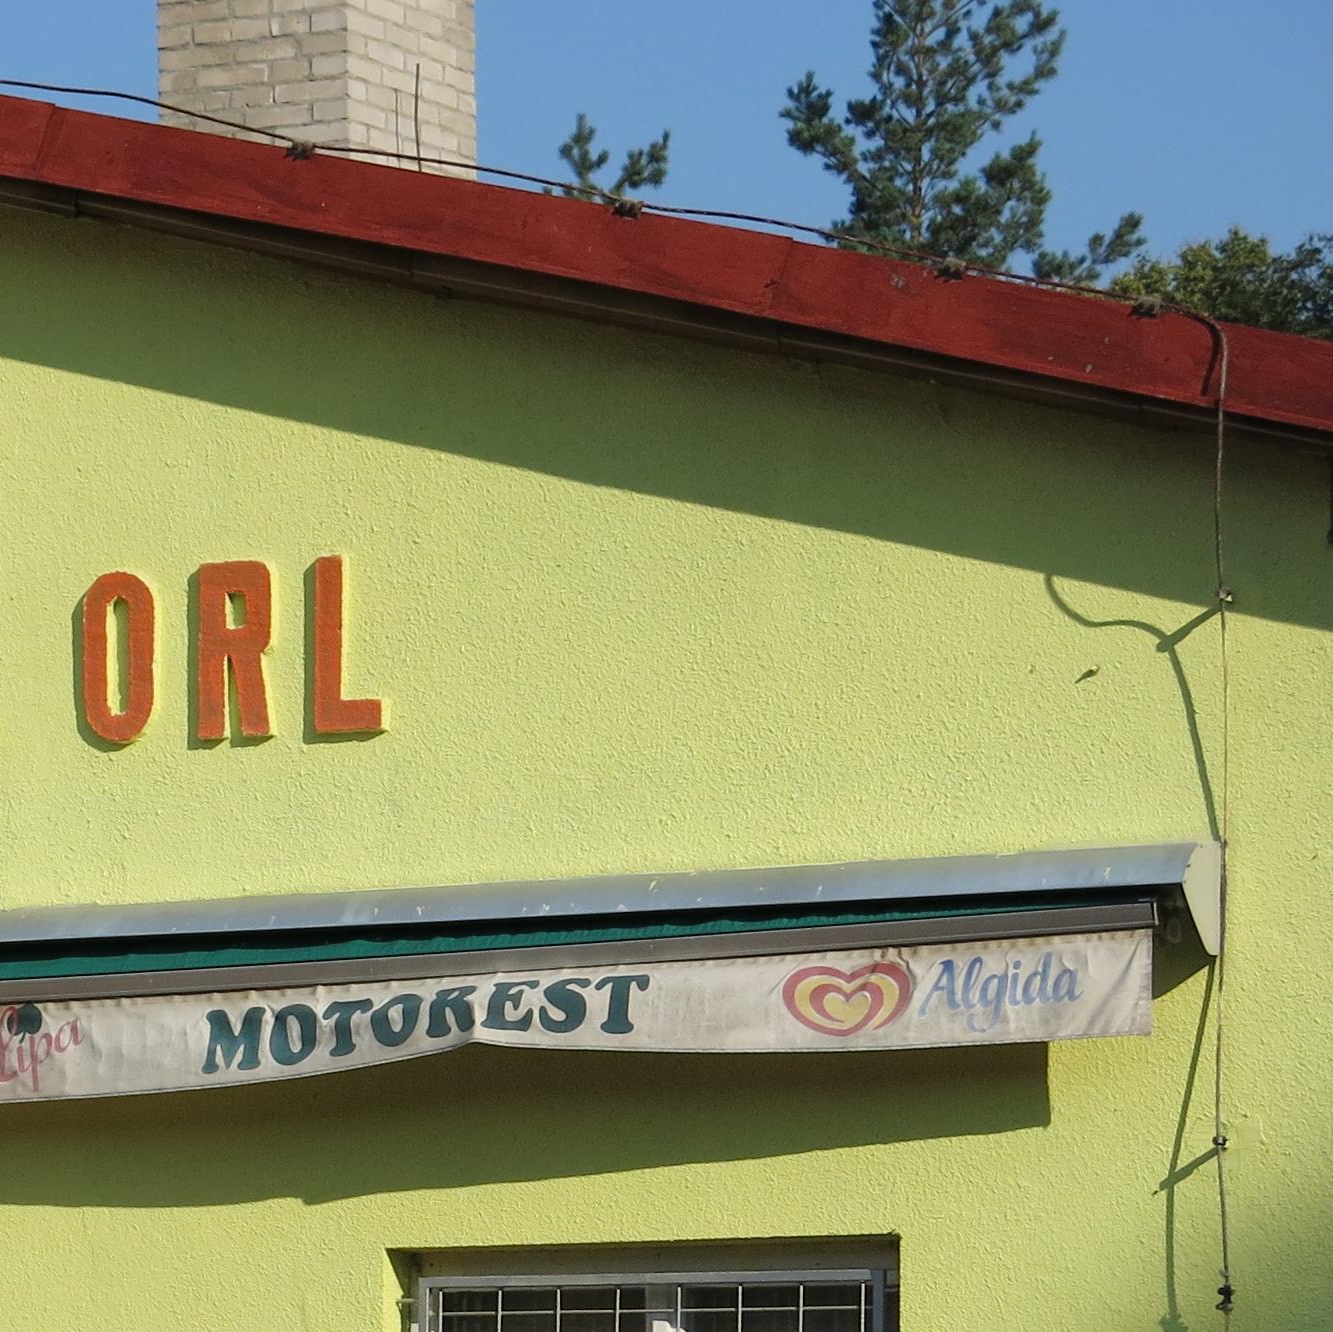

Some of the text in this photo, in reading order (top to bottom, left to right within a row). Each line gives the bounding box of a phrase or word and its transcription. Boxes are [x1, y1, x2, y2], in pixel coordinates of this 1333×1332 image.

[76, 553, 388, 748] ORL
[200, 974, 651, 1075] MOTOREST
[917, 951, 1085, 1033] Algida
